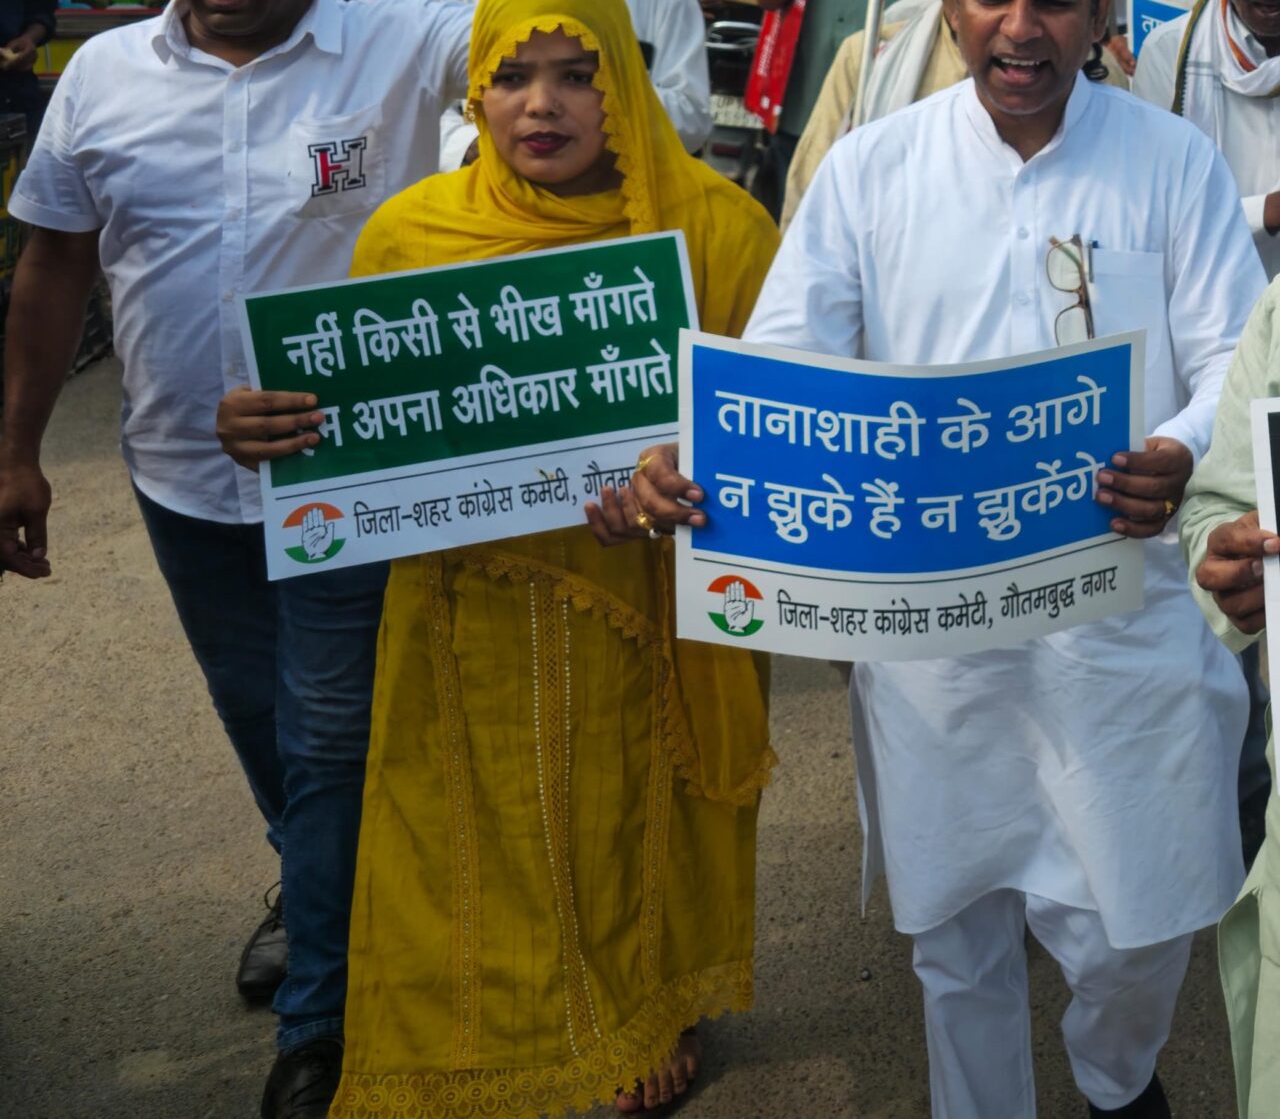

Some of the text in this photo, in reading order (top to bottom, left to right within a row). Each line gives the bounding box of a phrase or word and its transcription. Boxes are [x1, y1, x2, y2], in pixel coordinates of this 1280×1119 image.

[282, 266, 657, 376] नहीं किसी से भीख माँगते
[296, 339, 673, 457] म अपना अधिकार माँगते
[715, 376, 1106, 459] तानाशाही के आगे
[456, 479, 513, 518] कांग्रेस
[519, 468, 577, 507] कमेटी,
[716, 452, 1108, 543] न झुके हैं न झुकेंगे
[873, 598, 930, 635] कांग्रेस
[937, 591, 993, 631] कमेटी,
[1000, 578, 1075, 618] गौतमबुद्ध
[1081, 566, 1118, 596] नगर
